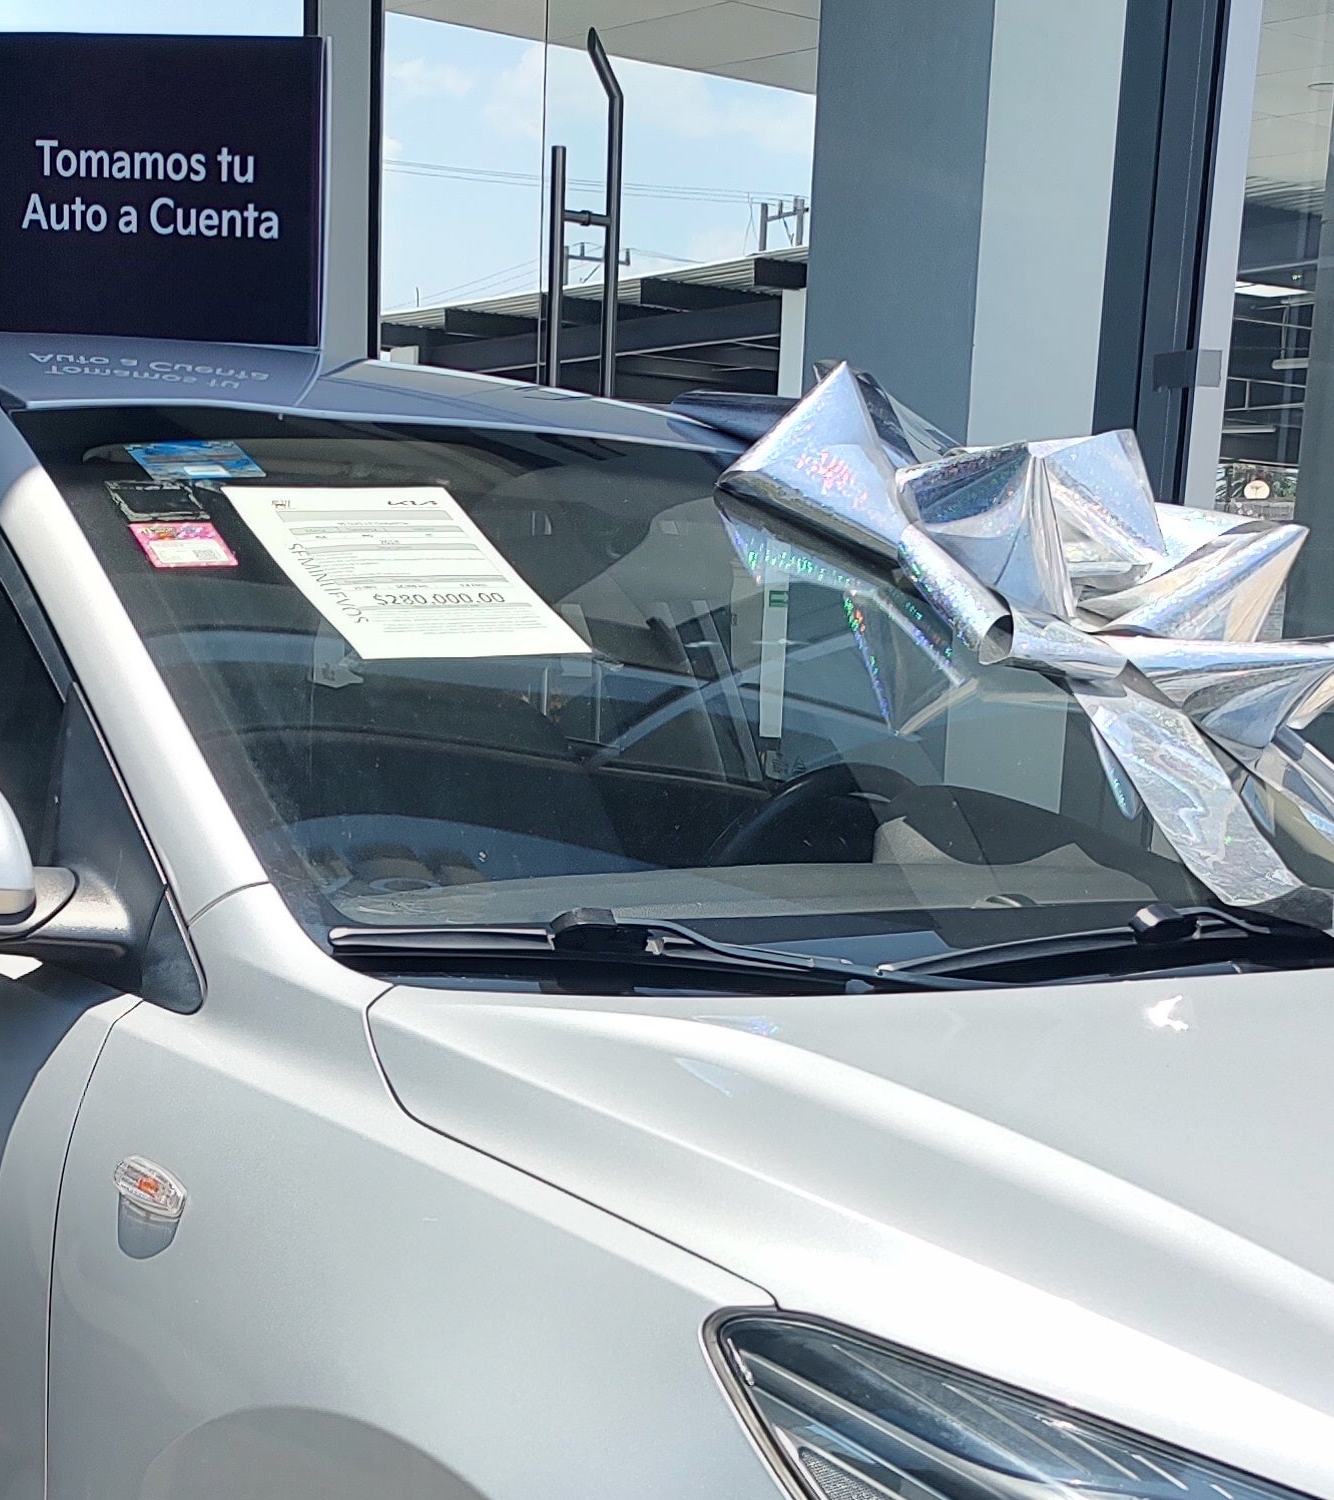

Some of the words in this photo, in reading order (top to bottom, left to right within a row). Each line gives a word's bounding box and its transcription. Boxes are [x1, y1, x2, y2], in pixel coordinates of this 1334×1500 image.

[35, 139, 207, 182] Tomamos
[217, 147, 255, 183] tu
[22, 193, 108, 232] Auto
[118, 205, 138, 233] a
[150, 197, 279, 239] Cuenta
